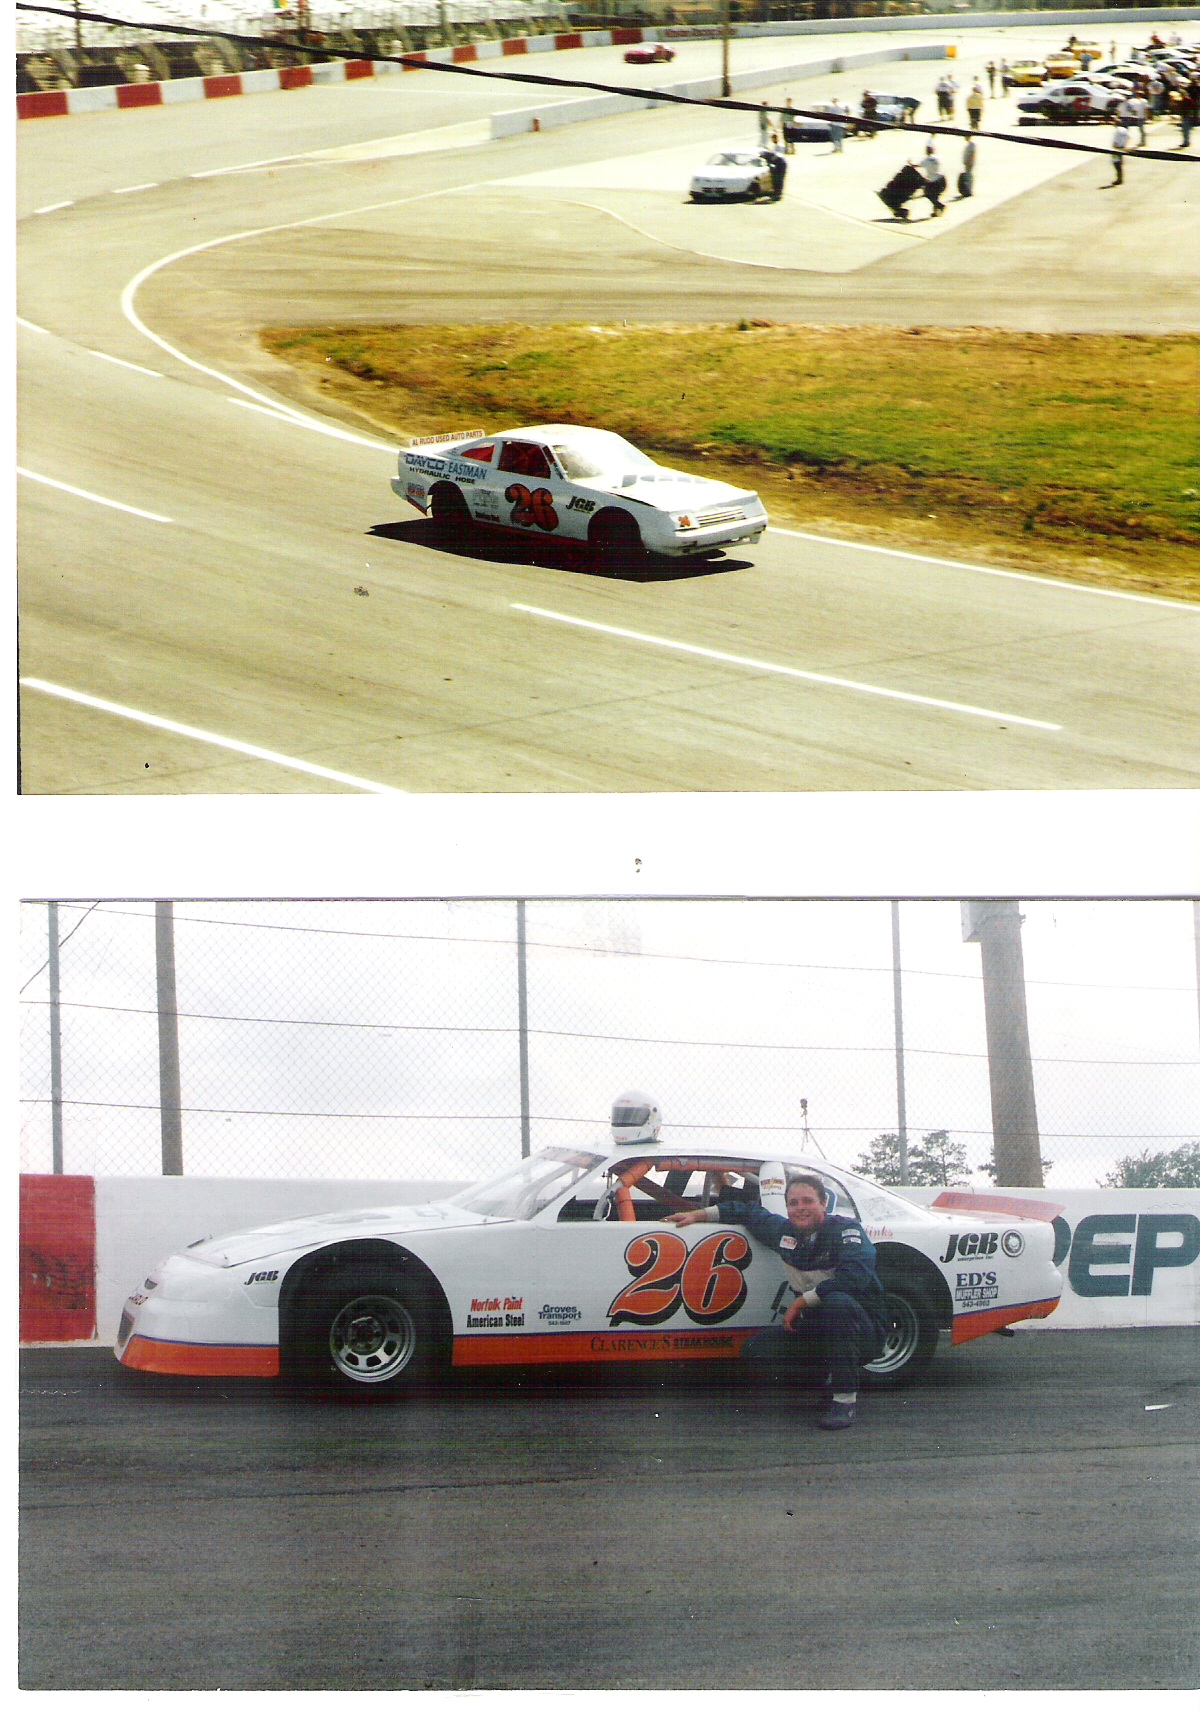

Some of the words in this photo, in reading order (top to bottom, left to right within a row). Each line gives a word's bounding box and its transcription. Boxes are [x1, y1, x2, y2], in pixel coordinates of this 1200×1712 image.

[436, 434, 450, 443] USED
[451, 432, 465, 441] AUTO
[466, 430, 483, 439] PARTS
[404, 453, 446, 471] DAYCO
[448, 462, 488, 480] EASTMAN
[409, 466, 451, 480] HYDRAULIC
[455, 476, 476, 485] HOSE
[504, 483, 560, 532] 26
[565, 495, 597, 512] JGB
[940, 1232, 999, 1264] JGB
[244, 1270, 279, 1285] JGB
[606, 1230, 753, 1327] 26
[956, 1271, 997, 1287] ED'S
[956, 1289, 981, 1300] MUFFLER
[982, 1287, 998, 1299] SHOP
[471, 1298, 501, 1312] Norfolk
[503, 1296, 524, 1311] Paint
[543, 1304, 578, 1314] Groves
[467, 1314, 503, 1328] American
[505, 1313, 525, 1327] Steel
[538, 1311, 582, 1320] Transport
